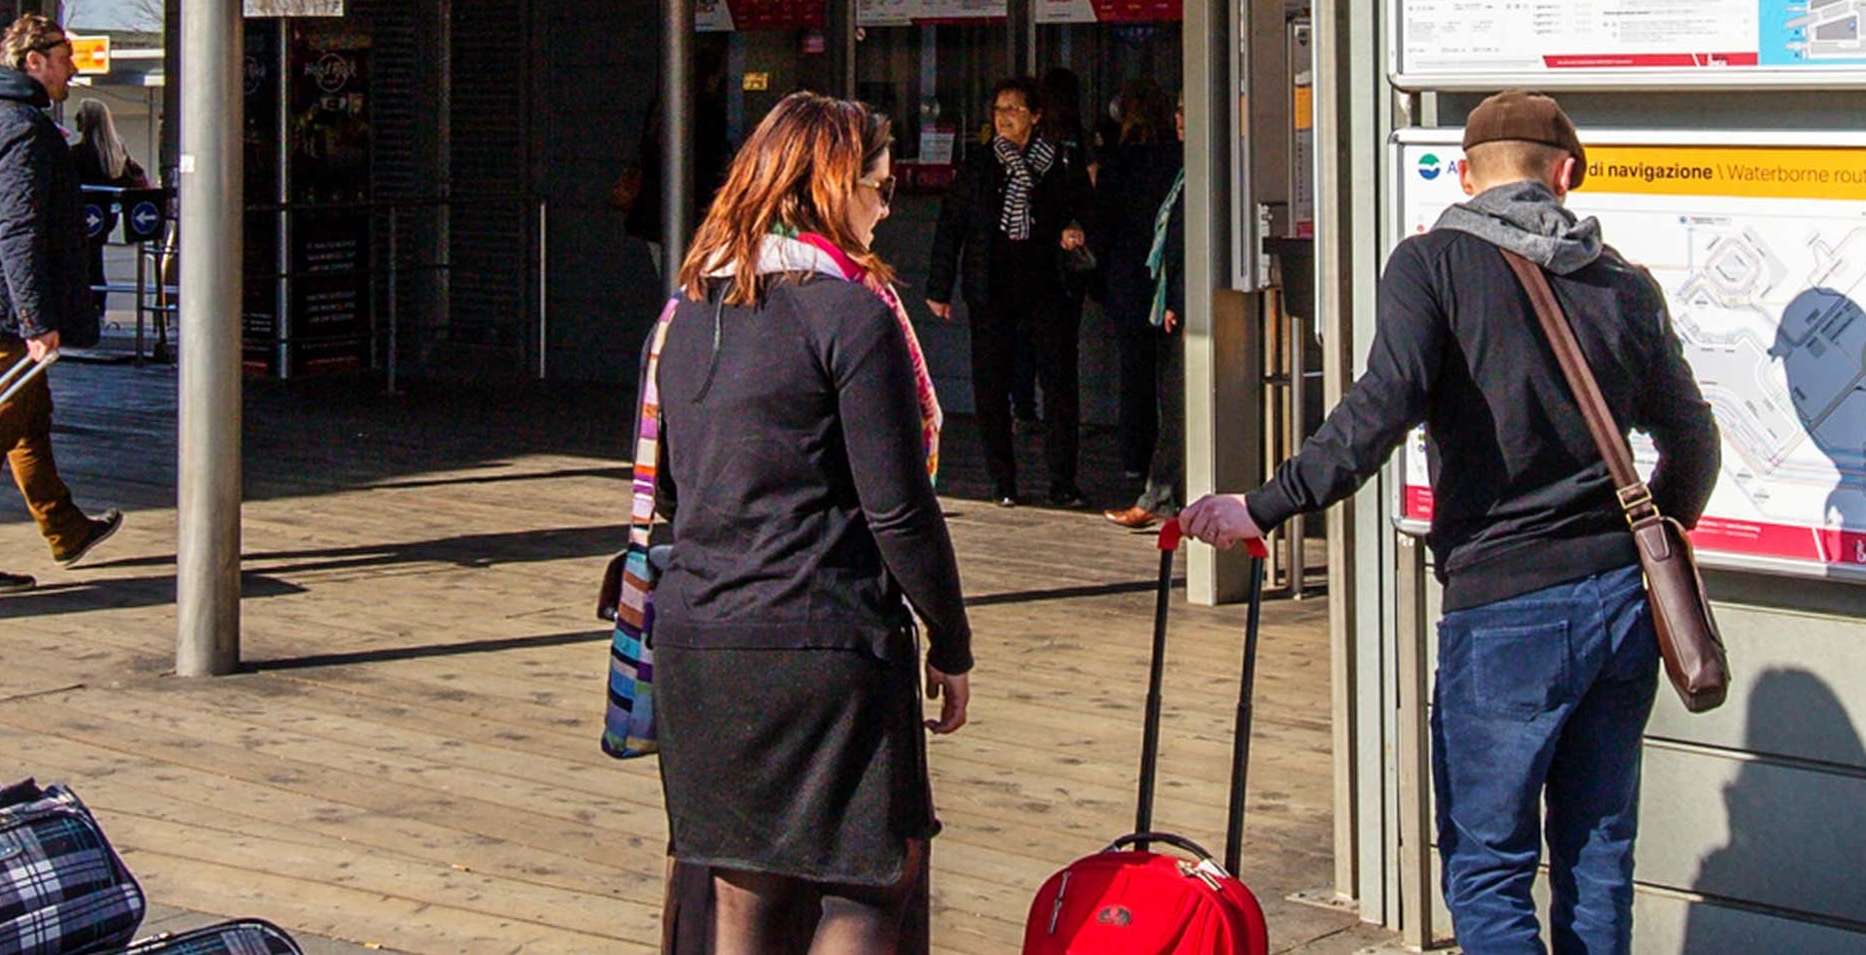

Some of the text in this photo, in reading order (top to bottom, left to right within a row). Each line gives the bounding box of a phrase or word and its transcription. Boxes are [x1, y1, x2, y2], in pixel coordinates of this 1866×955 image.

[1588, 160, 1604, 177] di
[1607, 162, 1713, 183] navigazione
[1727, 163, 1830, 184] Waterborne
